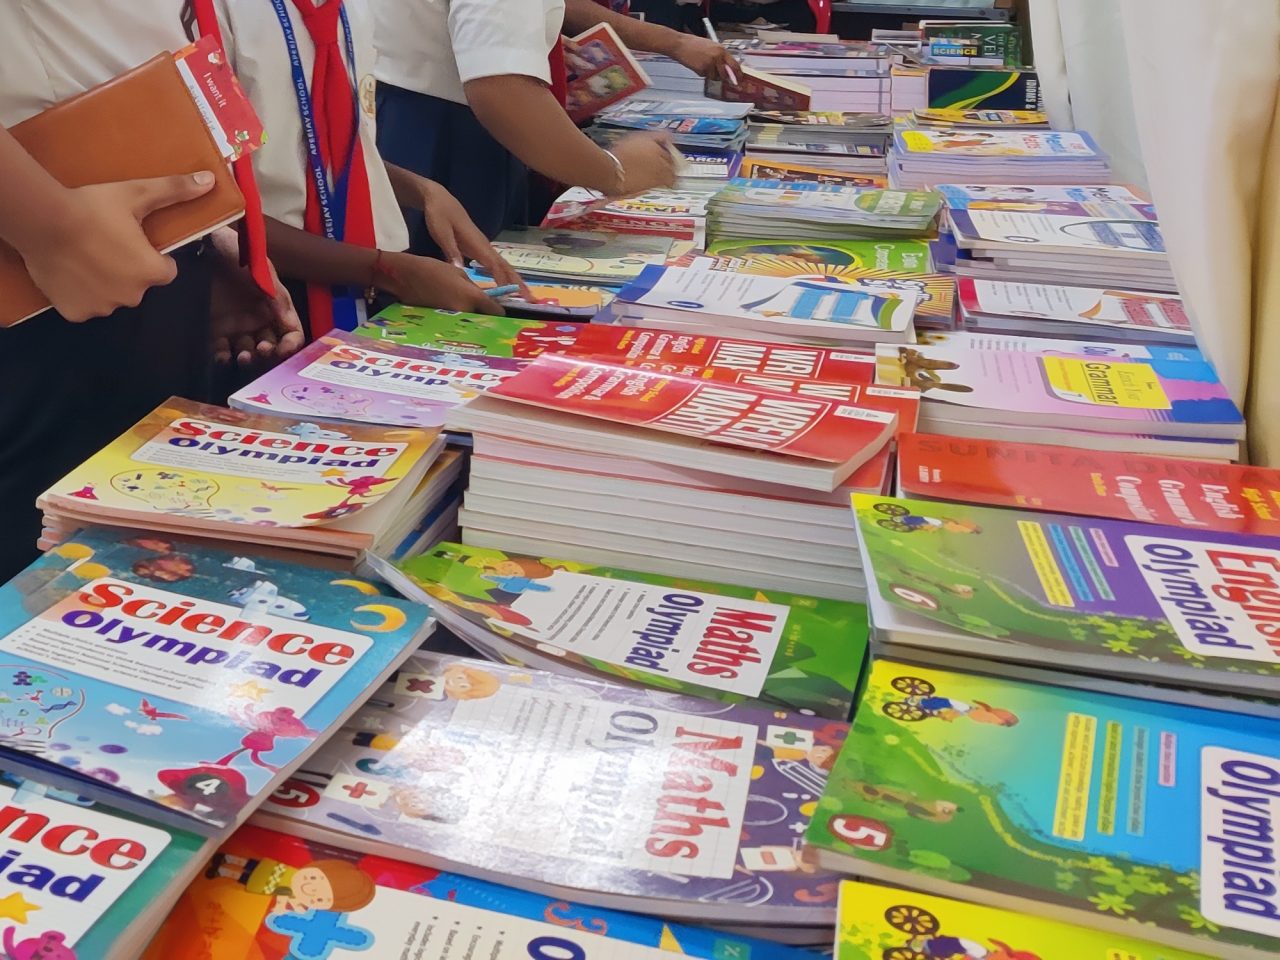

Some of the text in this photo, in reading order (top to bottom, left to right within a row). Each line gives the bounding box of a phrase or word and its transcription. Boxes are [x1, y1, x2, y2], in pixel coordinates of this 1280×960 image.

[932, 47, 977, 56] SCIENCE
[206, 78, 223, 100] want
[218, 99, 227, 108] it
[1025, 79, 1037, 102] IDIOMS
[295, 77, 318, 155] APEEJAY SCHOOL
[314, 166, 335, 239] PEEJAY SCHOOL
[555, 364, 605, 400] Composition
[588, 368, 628, 397] Grammar
[621, 371, 651, 397] English
[1084, 362, 1119, 406] Grammar
[173, 418, 398, 459] Science
[719, 395, 822, 443] WREN
[168, 437, 382, 469] Olympiad
[918, 439, 1107, 472] SUNITA
[1123, 457, 1280, 488] DIWA
[1200, 483, 1244, 520] English
[897, 585, 932, 609] 6
[1141, 543, 1255, 650] Olympiad
[77, 581, 356, 668] Science
[623, 593, 705, 672] Olympiad
[686, 606, 778, 679] Maths
[61, 608, 323, 689] Olympiad
[195, 778, 219, 797] 4
[644, 725, 744, 860] Maths
[831, 816, 887, 850] 5
[1206, 760, 1280, 921] Olympiad
